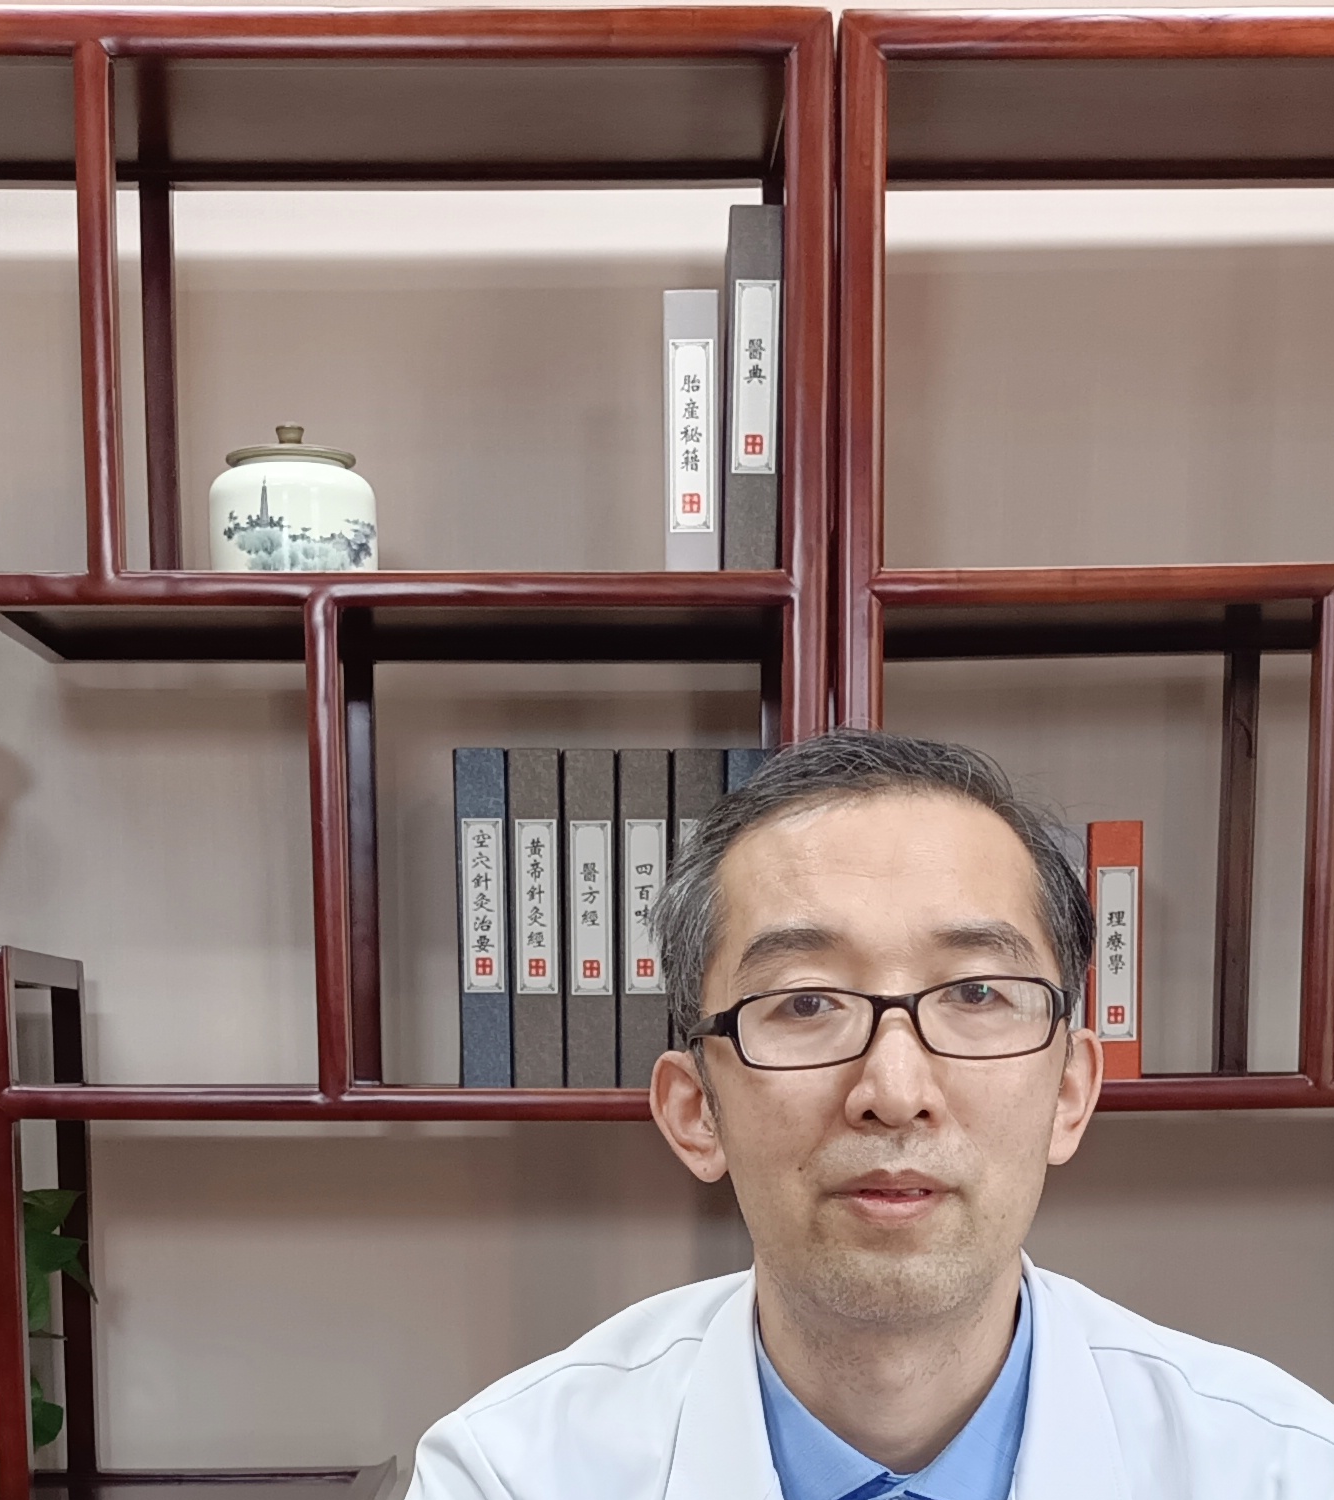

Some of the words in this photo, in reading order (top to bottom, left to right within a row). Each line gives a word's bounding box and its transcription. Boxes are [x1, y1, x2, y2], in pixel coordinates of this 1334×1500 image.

[744, 338, 767, 385] 醫典
[579, 861, 600, 927] 醫方經
[1106, 910, 1127, 975] 理療學
